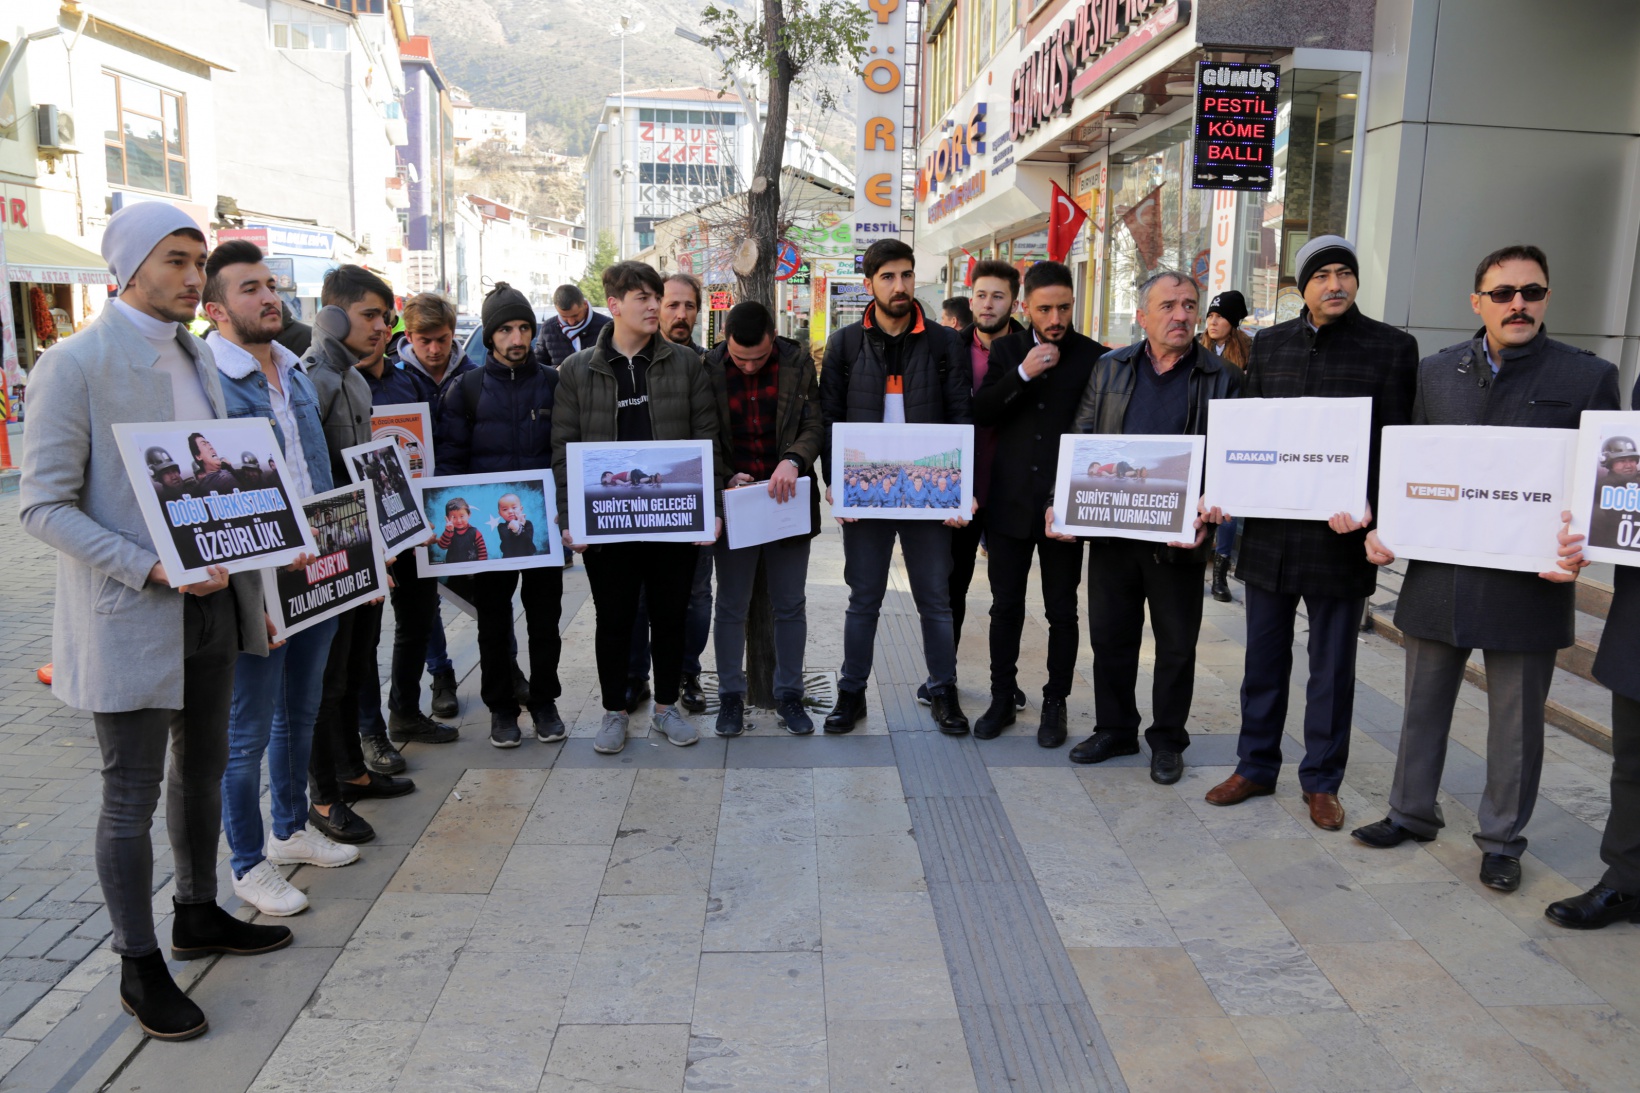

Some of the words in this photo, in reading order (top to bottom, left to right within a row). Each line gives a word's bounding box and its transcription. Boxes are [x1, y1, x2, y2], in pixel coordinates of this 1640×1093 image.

[1203, 67, 1275, 91] GÜMÜŞ
[1204, 95, 1272, 114] PESTİL
[1208, 120, 1265, 138] KÖME
[925, 103, 987, 194] YÖRE
[1208, 145, 1262, 161] BALLI
[855, 221, 900, 233] PESTİL
[1228, 452, 1275, 462] ARAKAN
[1302, 453, 1323, 463] SES
[1326, 454, 1349, 463] VER
[592, 497, 649, 514] SURİYE'NİN
[650, 494, 697, 511] GELECEĞİ
[1075, 488, 1130, 506] SURİYE'NİN
[1131, 492, 1179, 509] GELECEĞİ
[1409, 485, 1456, 498] YEMEN
[1492, 490, 1518, 501] SES
[1522, 491, 1552, 503] VER
[166, 494, 210, 528] DOĞU
[204, 487, 287, 521] TÜRKİSTAN'A
[1077, 506, 1111, 522] KIYIYA
[1113, 509, 1172, 526] VURMASIN!
[597, 515, 632, 530] KIYIYA
[634, 512, 693, 529] VURMASIN!
[193, 517, 286, 562] ÖZGÜRLÜK!
[306, 552, 349, 584] MISIR'IN
[288, 581, 336, 618] ZULMÜNE
[337, 575, 355, 596] DUR
[355, 568, 372, 591] DE!
